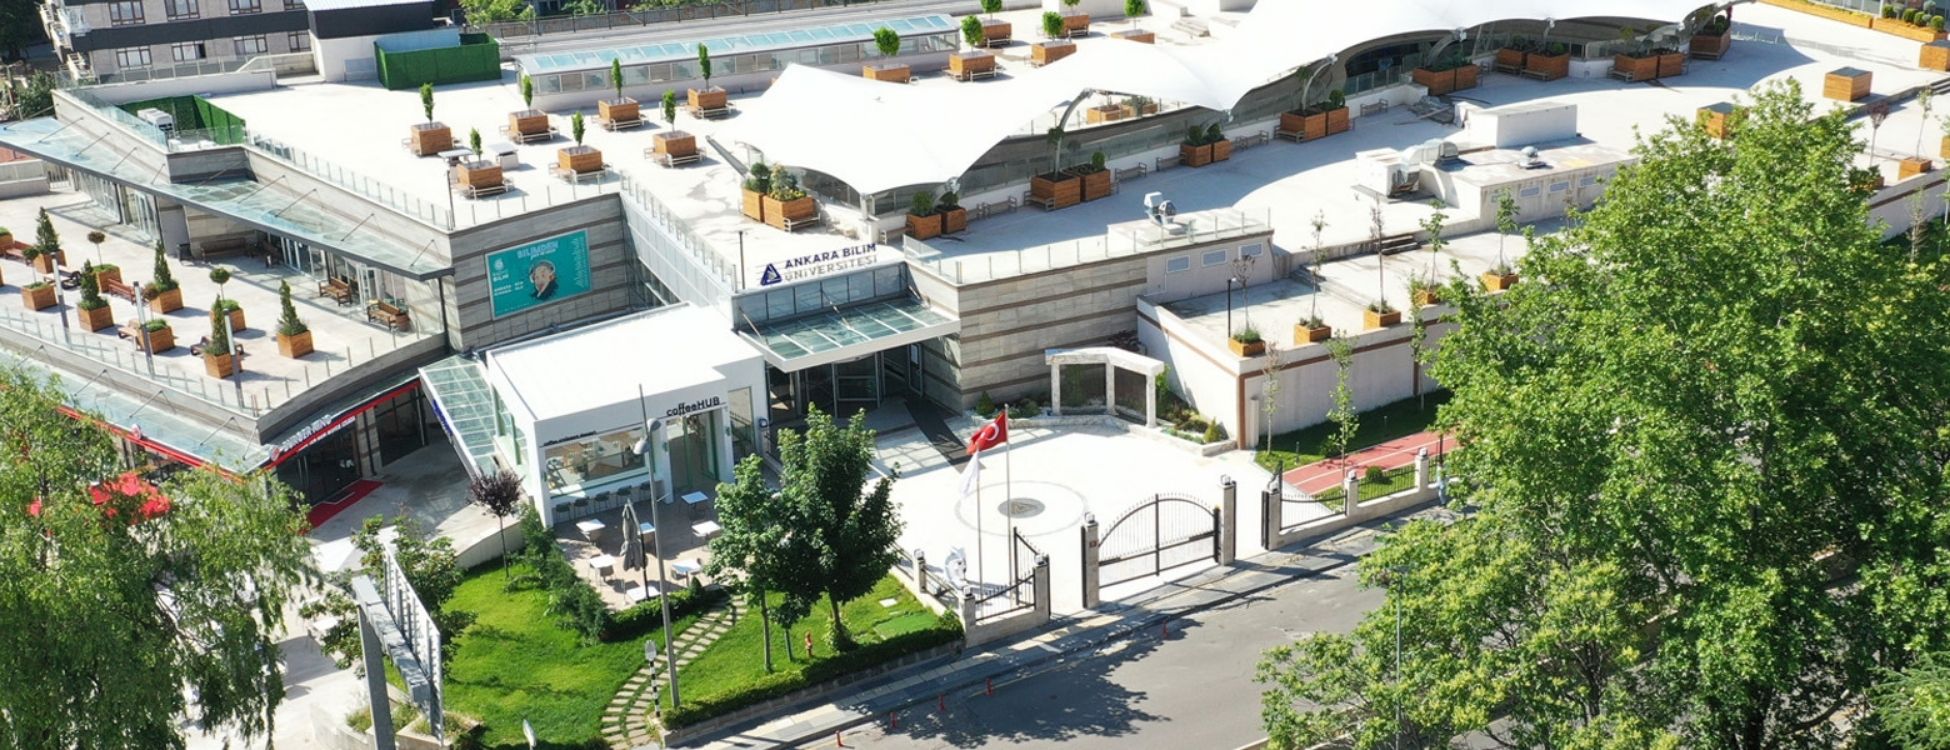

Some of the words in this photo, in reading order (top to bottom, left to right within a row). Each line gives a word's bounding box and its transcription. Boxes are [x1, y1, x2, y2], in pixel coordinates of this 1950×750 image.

[785, 250, 840, 269] ANKARA
[843, 243, 876, 257] BİLİM
[666, 395, 720, 416] coffeeHUB
